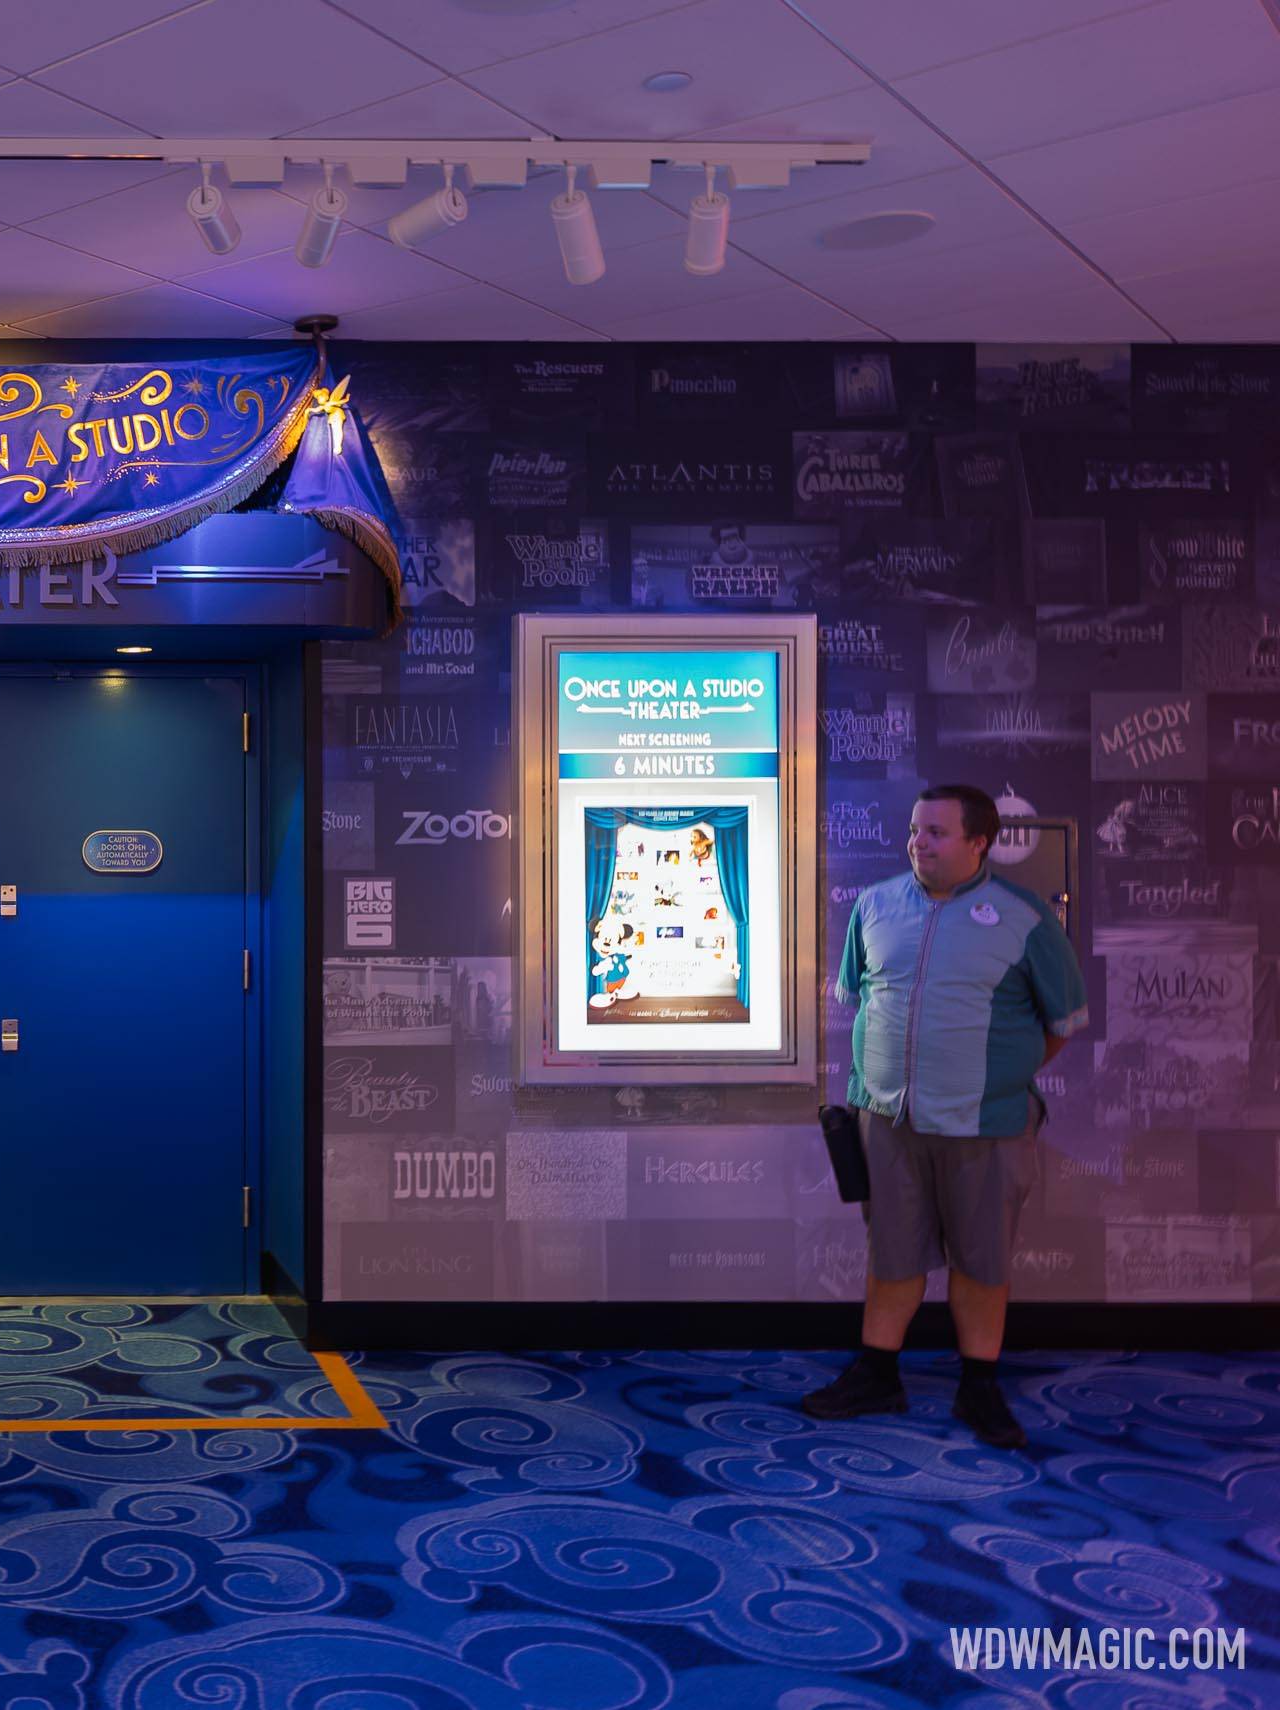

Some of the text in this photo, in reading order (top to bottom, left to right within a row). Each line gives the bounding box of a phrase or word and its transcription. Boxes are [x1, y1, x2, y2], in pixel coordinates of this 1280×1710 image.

[534, 360, 605, 377] Rescuers
[649, 368, 737, 394] Pinocchio
[26, 430, 58, 468] A
[66, 402, 211, 463] STUDIO
[488, 451, 567, 477] Peter Pan
[607, 459, 775, 484] ATLANTIS
[824, 448, 881, 473] THREE
[797, 455, 905, 501] CABALLEROS
[504, 534, 600, 562] Winnie
[522, 556, 591, 588] Pooh
[692, 579, 778, 596] RALPH
[406, 626, 475, 656] ICHABOD
[817, 624, 882, 641] GREAT
[817, 640, 885, 654] MOUSE
[944, 614, 1018, 681] Bambi
[405, 663, 423, 675] and
[444, 661, 475, 675] Toad
[564, 676, 765, 701] ONCE UPON A STUDIO
[628, 701, 700, 720] THEATER
[818, 706, 907, 737] Winnie
[985, 708, 1042, 735] FANTASIA
[354, 704, 459, 745] FANTASIA
[1097, 699, 1193, 756] MELODY
[618, 732, 712, 747] NEXT SCREENING
[830, 733, 897, 762] Pooh
[1124, 730, 1187, 769] TIME
[614, 755, 716, 776] 6 MINUTES
[1138, 783, 1188, 805] ALICE
[322, 809, 362, 833] Stone
[831, 800, 881, 820] Fox
[108, 835, 138, 843] CAUTION
[394, 809, 512, 846] ZOOTO
[821, 820, 892, 849] Hound
[96, 851, 149, 859] AUTOMATICALLY
[101, 843, 147, 851] DOORS OPEN
[346, 880, 393, 901] BIG
[1120, 878, 1221, 918] Tangled
[346, 901, 393, 914] HERO
[346, 913, 393, 946] 6
[1134, 967, 1226, 1005] MULAN
[323, 1055, 422, 1093] Beauty
[347, 1084, 434, 1120] BEAST
[393, 1150, 496, 1200] DUMBO
[644, 1154, 766, 1184] HERCULES
[358, 1255, 473, 1275] LION KING
[695, 1252, 713, 1268] THE
